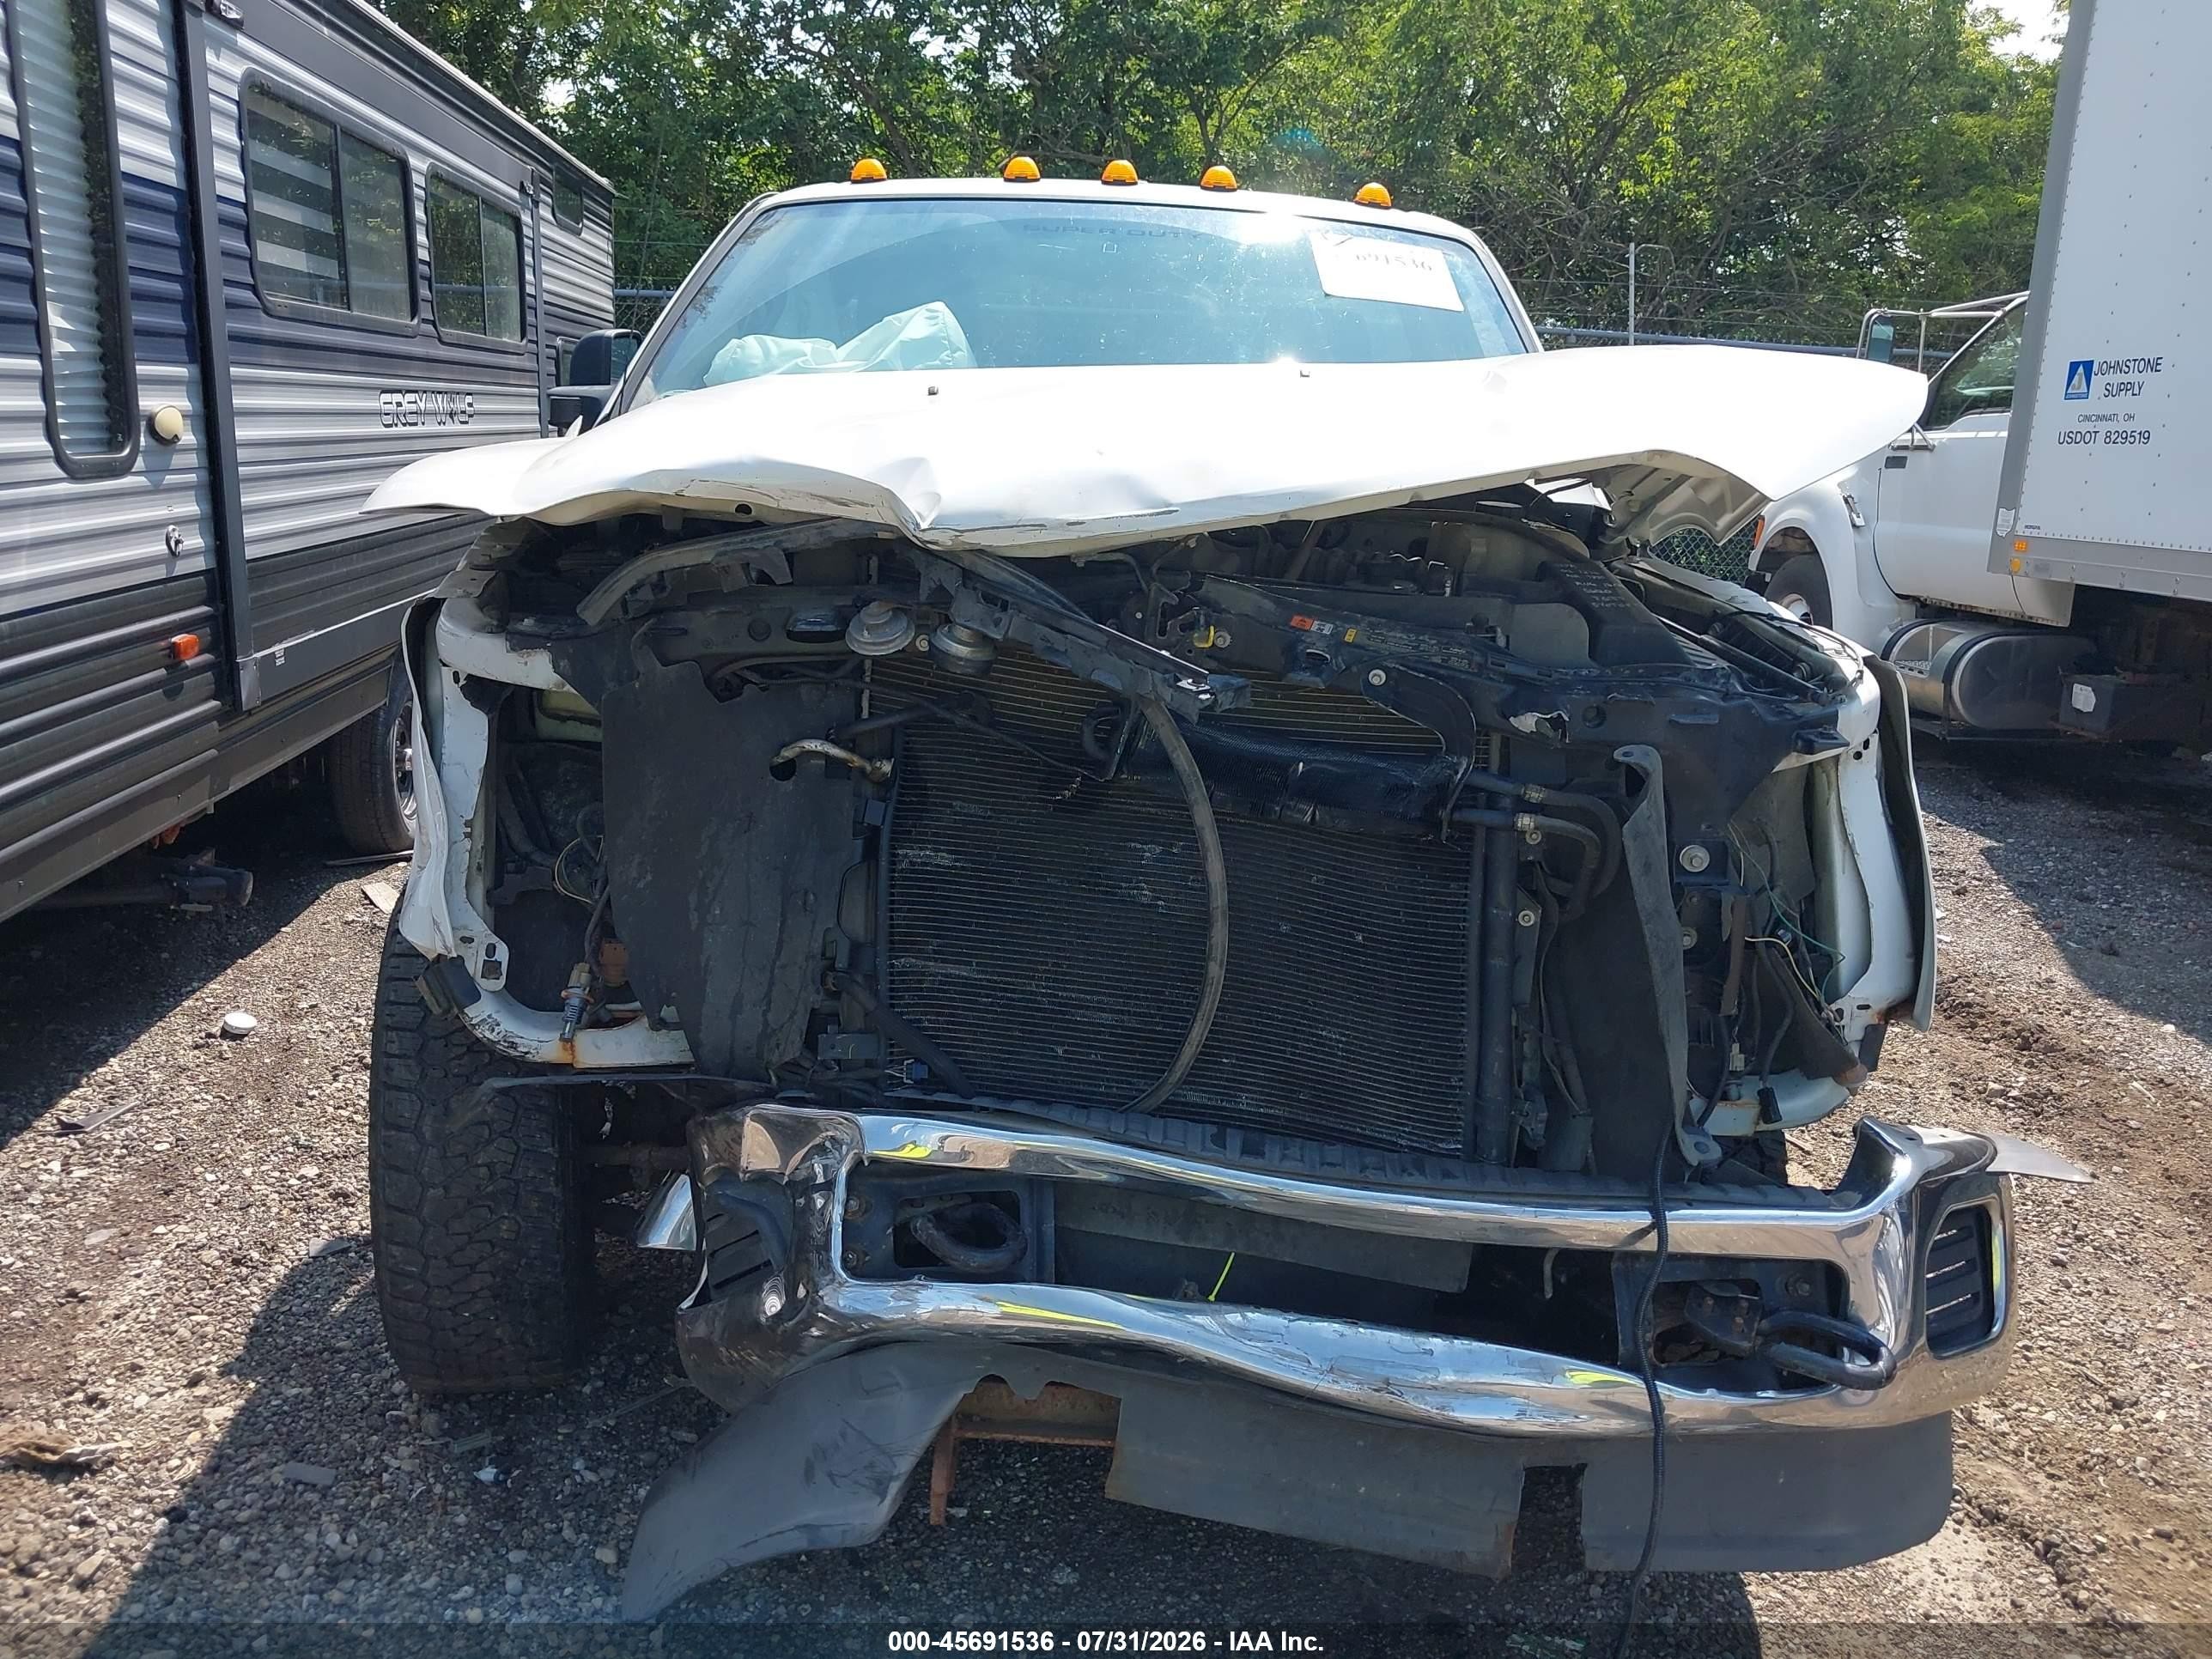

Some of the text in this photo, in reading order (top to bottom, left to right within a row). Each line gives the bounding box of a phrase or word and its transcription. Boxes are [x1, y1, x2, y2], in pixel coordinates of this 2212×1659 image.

[2094, 356, 2164, 376] JOHNSTONE
[2103, 380, 2145, 398] SUPPLY
[380, 390, 427, 428] GREY
[2077, 412, 2136, 424] CINCINNATI, OH
[2057, 429, 2151, 445] USDOT 829519
